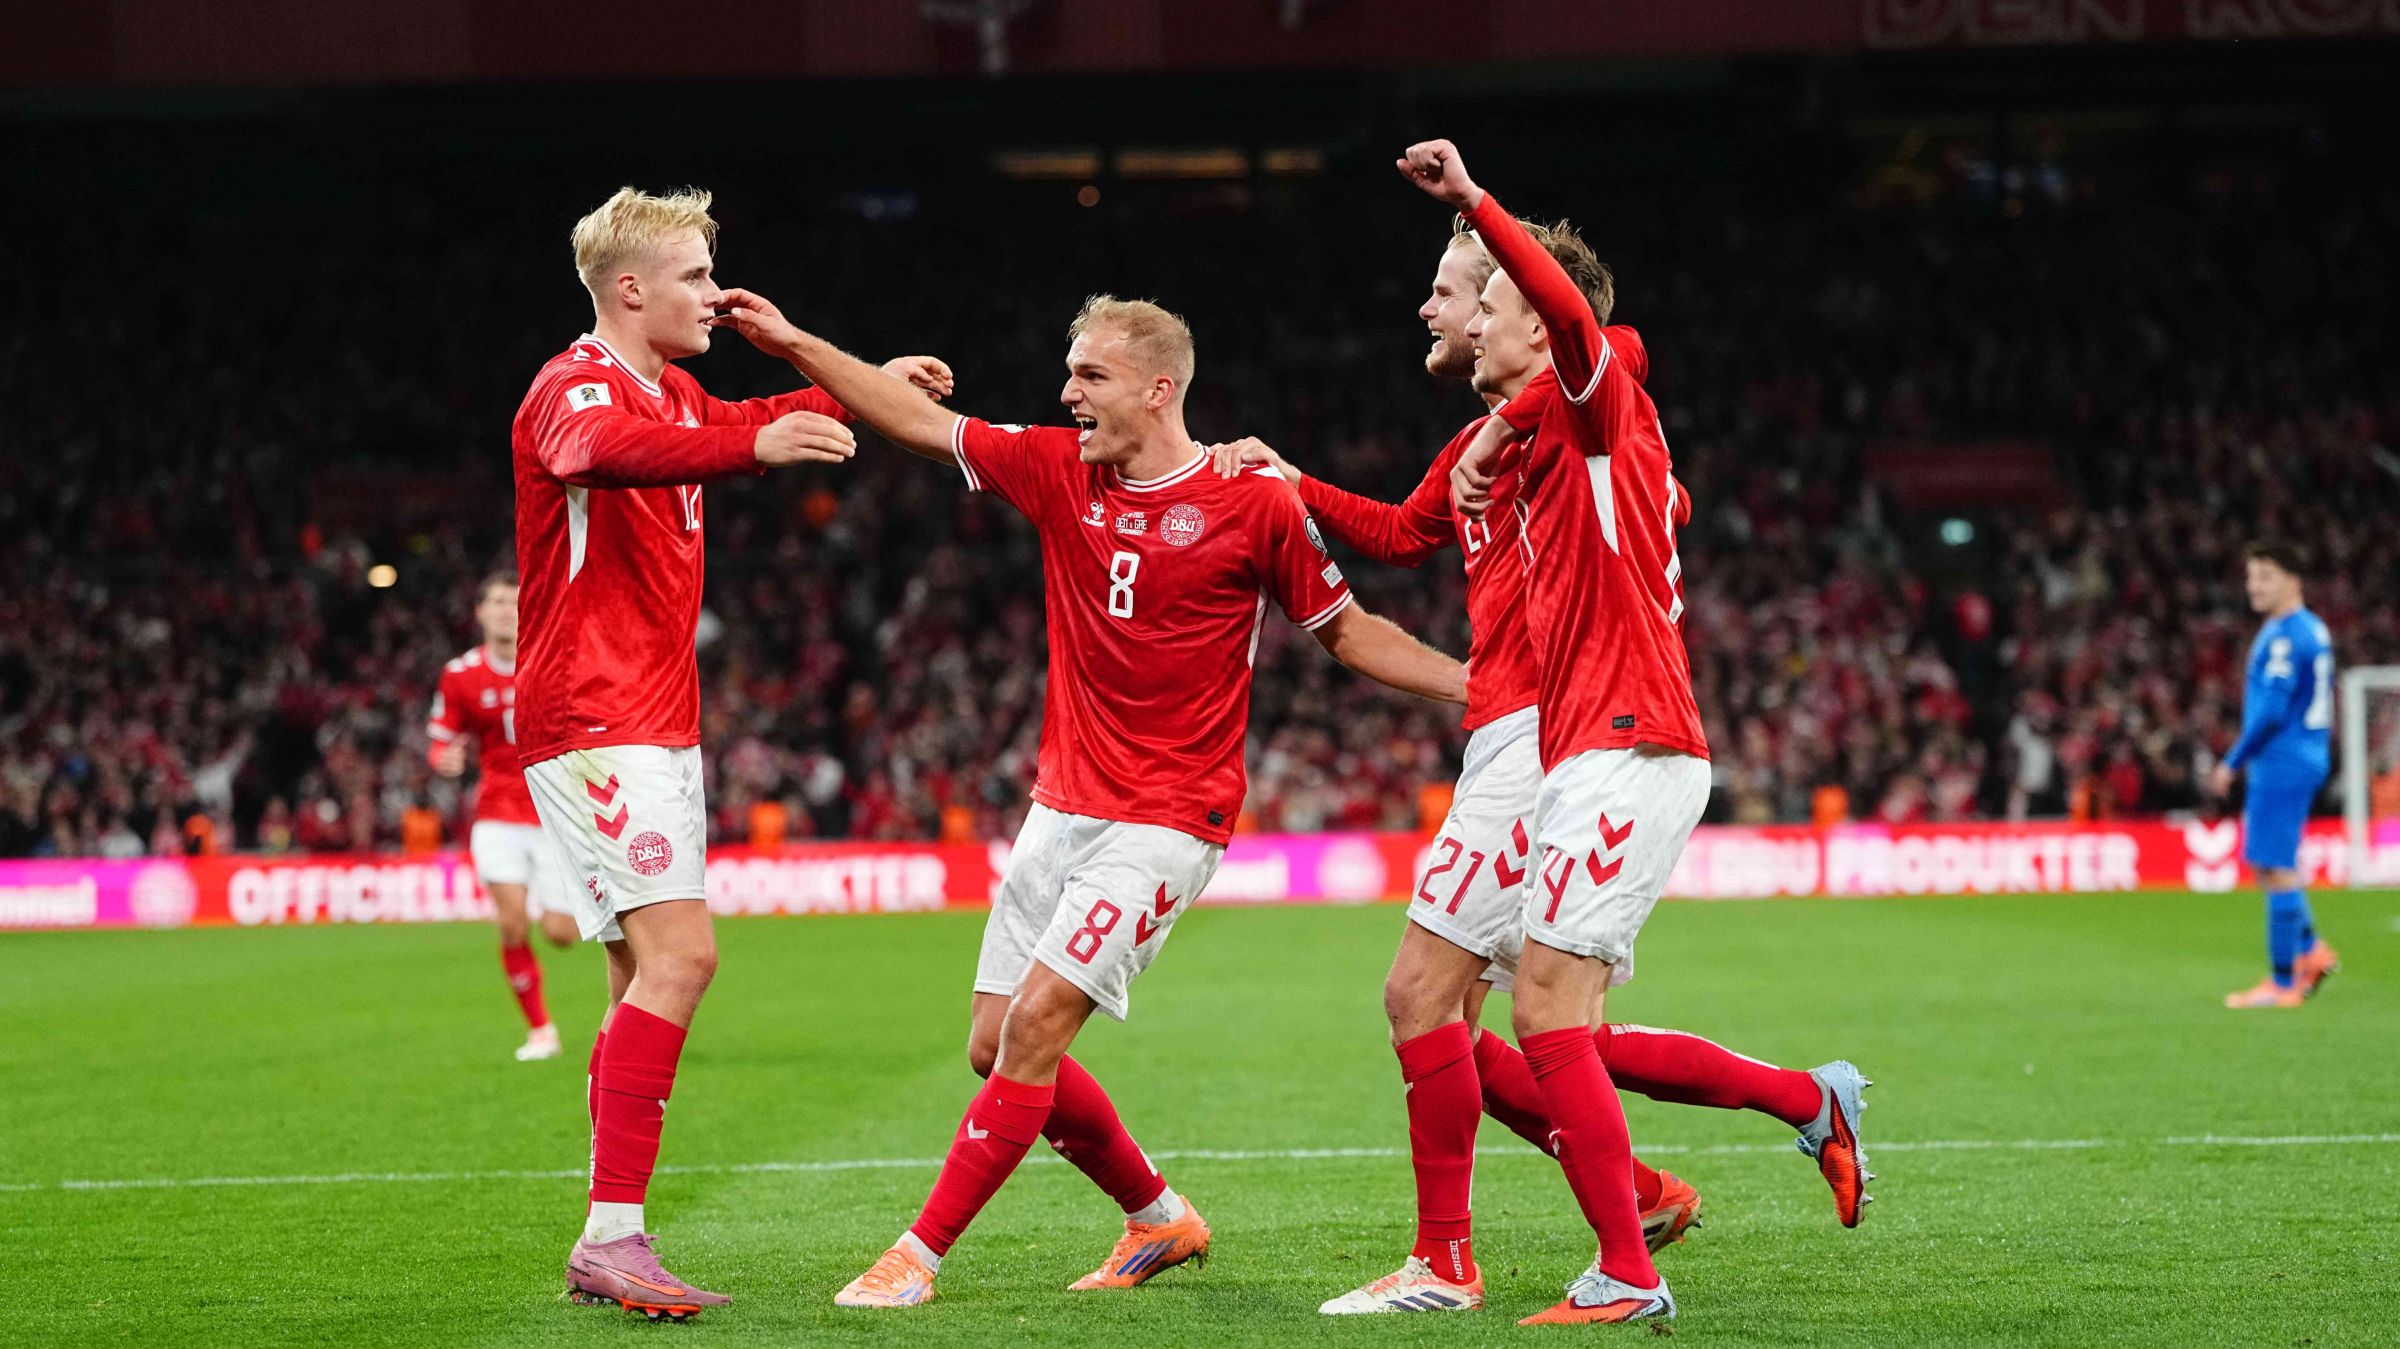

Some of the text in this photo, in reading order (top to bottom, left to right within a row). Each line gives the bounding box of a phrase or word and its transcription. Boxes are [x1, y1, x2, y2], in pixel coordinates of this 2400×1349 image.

[1170, 518, 1196, 532] DBU
[1108, 551, 1141, 619] 8
[635, 845, 665, 861] DBU
[1417, 836, 1486, 917] 21
[227, 854, 947, 925] OFFICIELL ODUKTER
[1065, 899, 1122, 965] 8
[1449, 1239, 1464, 1280] DESIGN
